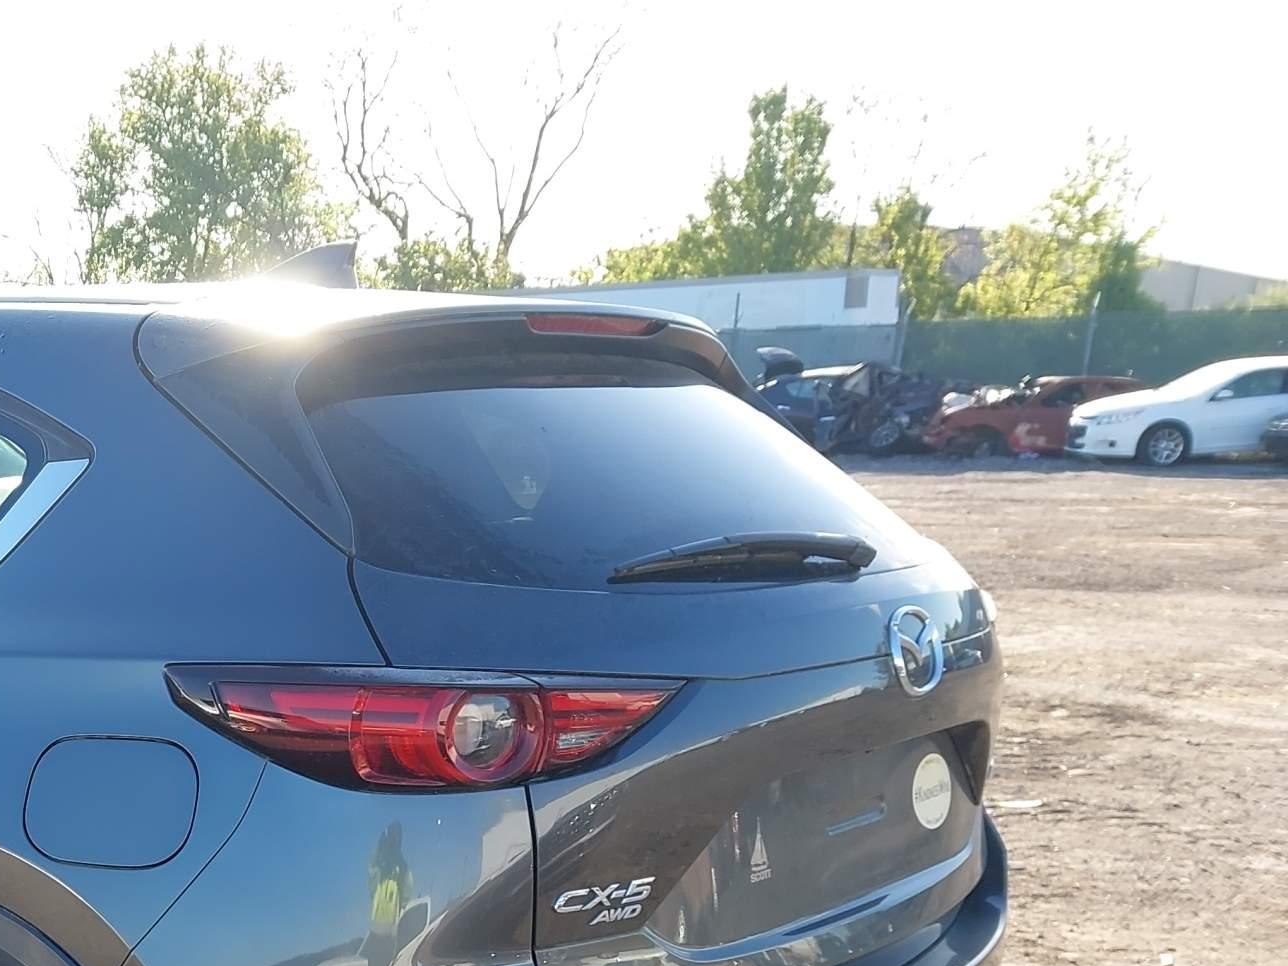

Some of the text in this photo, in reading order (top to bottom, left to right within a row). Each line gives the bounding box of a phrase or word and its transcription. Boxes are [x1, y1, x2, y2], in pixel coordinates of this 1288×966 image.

[750, 868, 772, 883] SCOTT
[554, 876, 656, 913] CX-5
[589, 904, 642, 925] AWD
